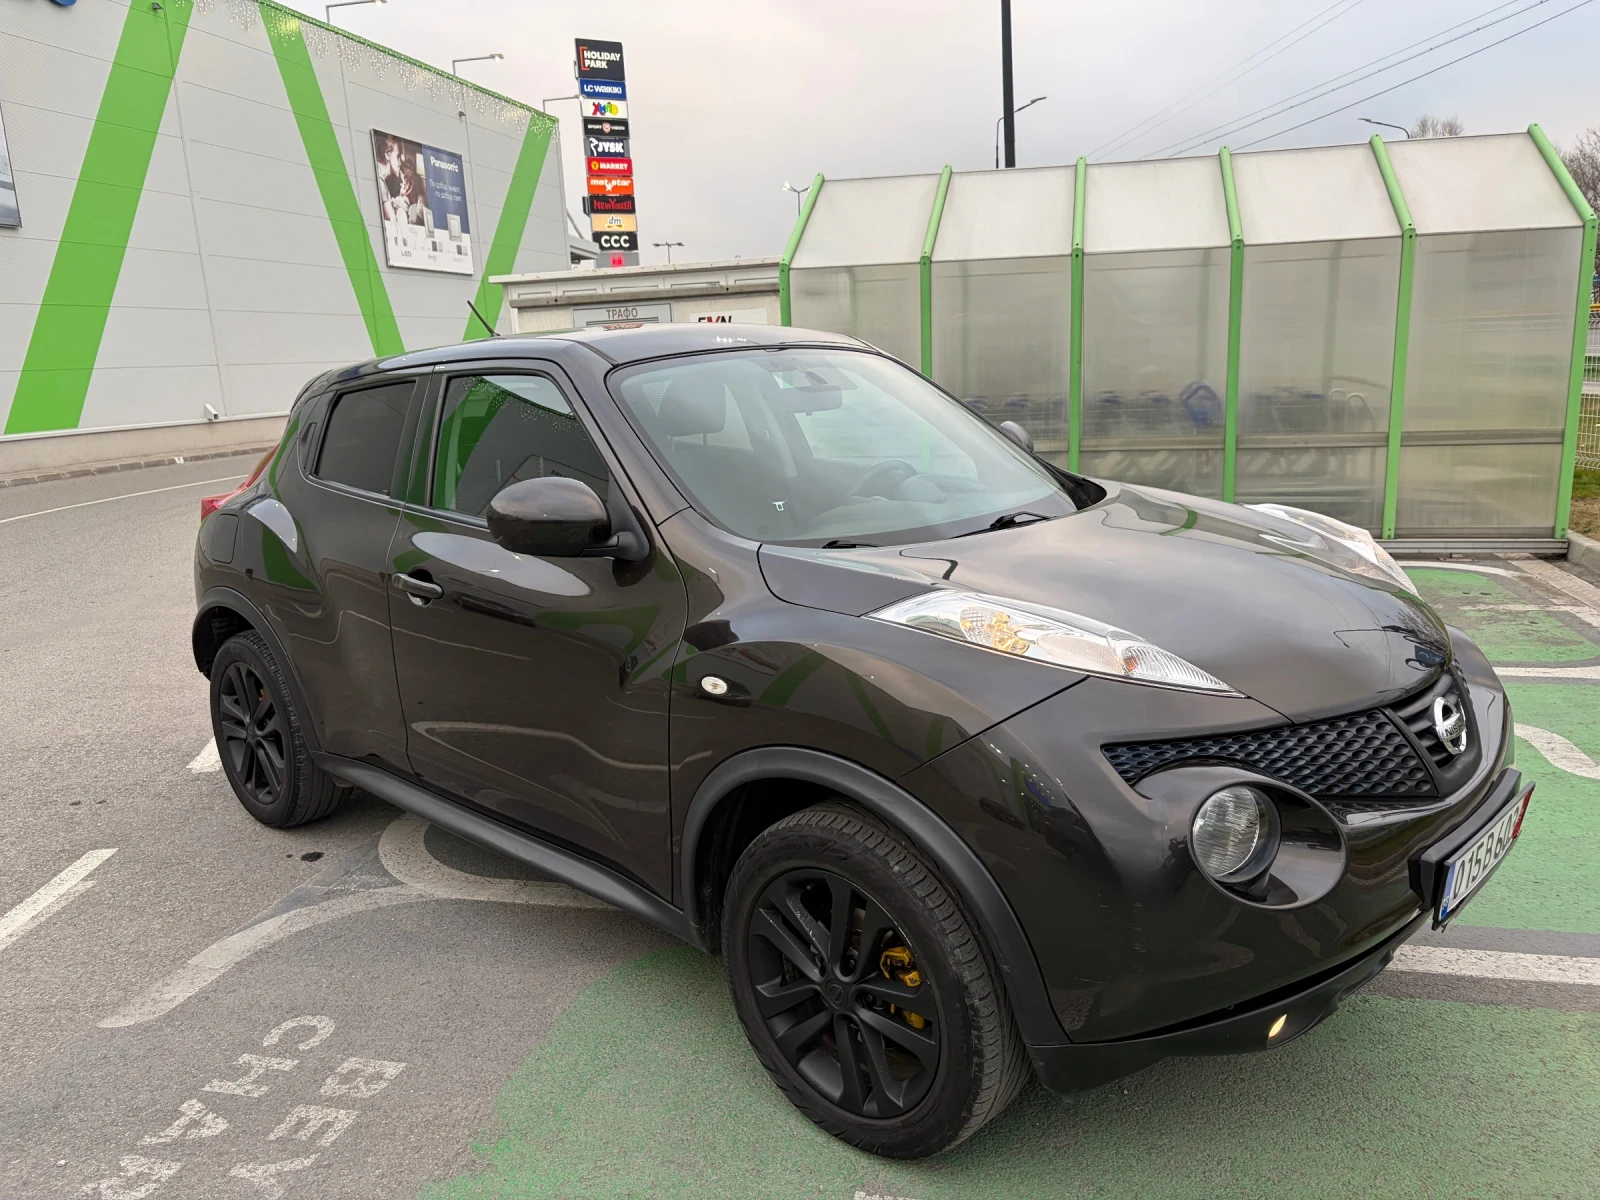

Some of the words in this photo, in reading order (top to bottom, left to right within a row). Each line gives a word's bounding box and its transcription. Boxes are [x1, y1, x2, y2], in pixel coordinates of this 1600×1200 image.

[583, 50, 621, 61] HOLIDAY
[584, 59, 608, 69] PARK
[584, 84, 594, 92] LC
[597, 142, 624, 153] JYSK
[430, 156, 459, 172] Panasonic
[600, 162, 628, 170] MARKET
[608, 216, 622, 224] dm
[601, 235, 630, 247] CCC
[606, 307, 638, 319] ТРАФО
